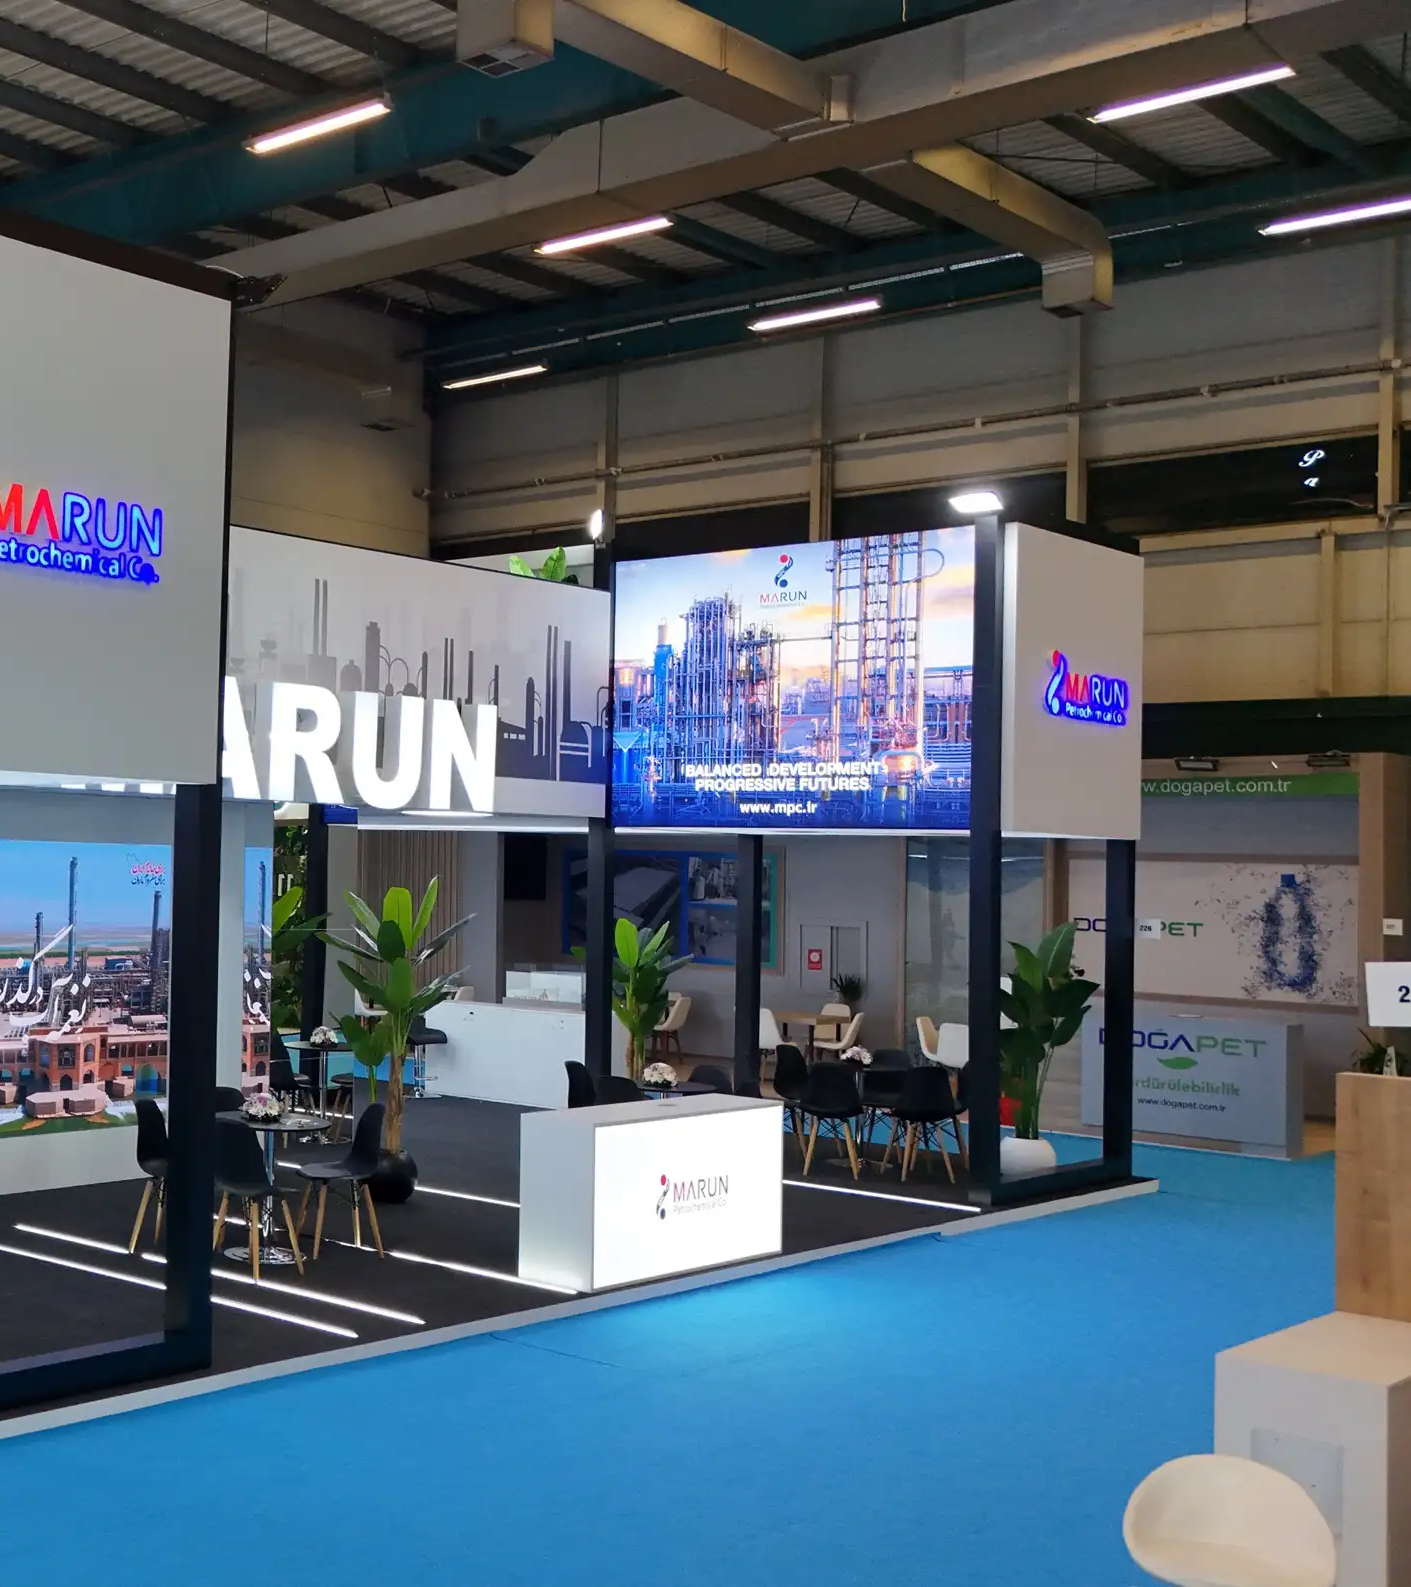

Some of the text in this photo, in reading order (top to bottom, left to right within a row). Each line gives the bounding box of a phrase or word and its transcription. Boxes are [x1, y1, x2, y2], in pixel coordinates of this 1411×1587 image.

[759, 591, 807, 603] MARUN
[1065, 671, 1126, 709] MARUN
[223, 676, 497, 812] ARUN
[685, 761, 882, 777] BALANCED DEVELOPMENT
[695, 778, 870, 791] PROGRESSIVE FUTURES
[1141, 778, 1291, 796] w.dogapet.com.tr
[739, 800, 818, 816] www.mpc.ir
[1099, 1027, 1267, 1058] OĞAPET
[1132, 1076, 1240, 1097] rdürülebilirlik
[1137, 1097, 1226, 1113] www.dogapet.com.tr
[673, 1174, 728, 1203] MARUN
